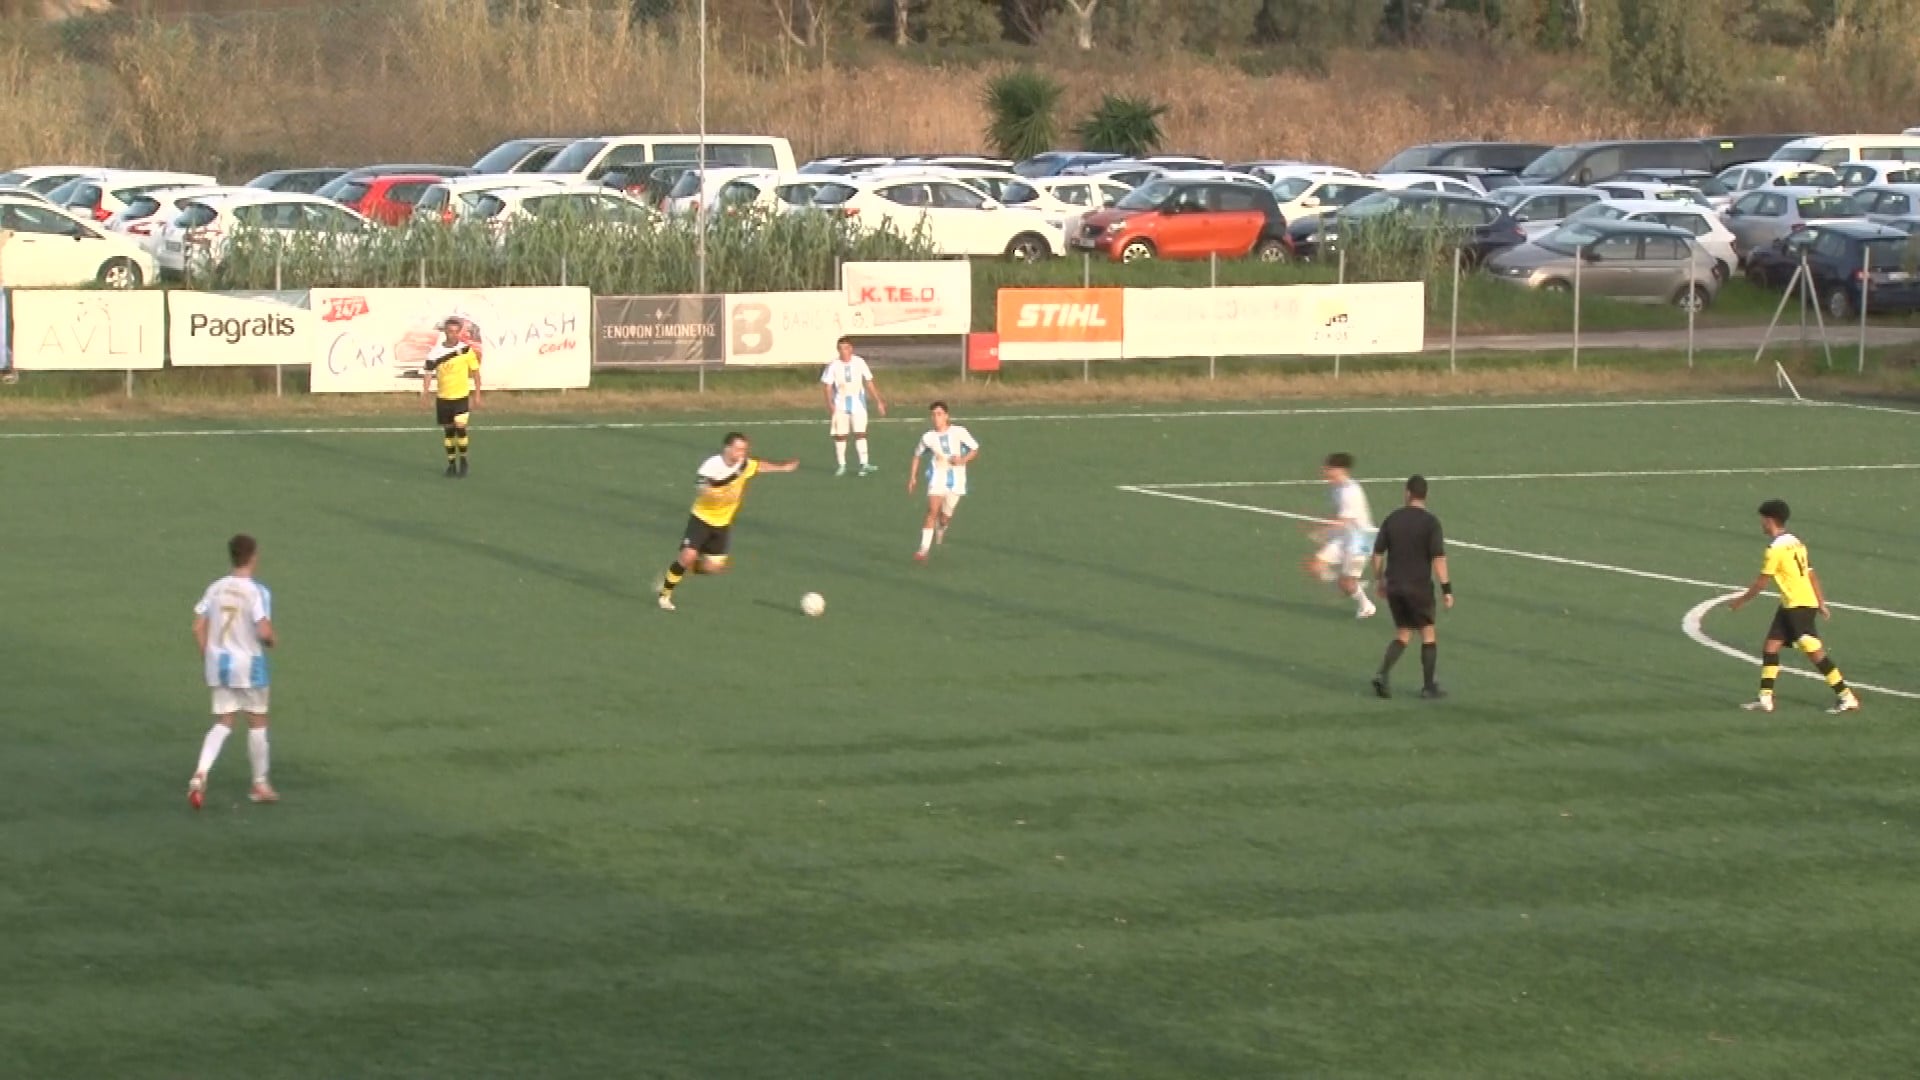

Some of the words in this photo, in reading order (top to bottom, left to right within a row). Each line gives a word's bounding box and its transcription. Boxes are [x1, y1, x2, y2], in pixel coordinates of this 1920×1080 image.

[190, 313, 296, 344] Pagratis
[734, 304, 774, 355] B
[1016, 303, 1107, 327] STIHL
[38, 324, 144, 355] AVLI
[217, 605, 241, 646] 7
